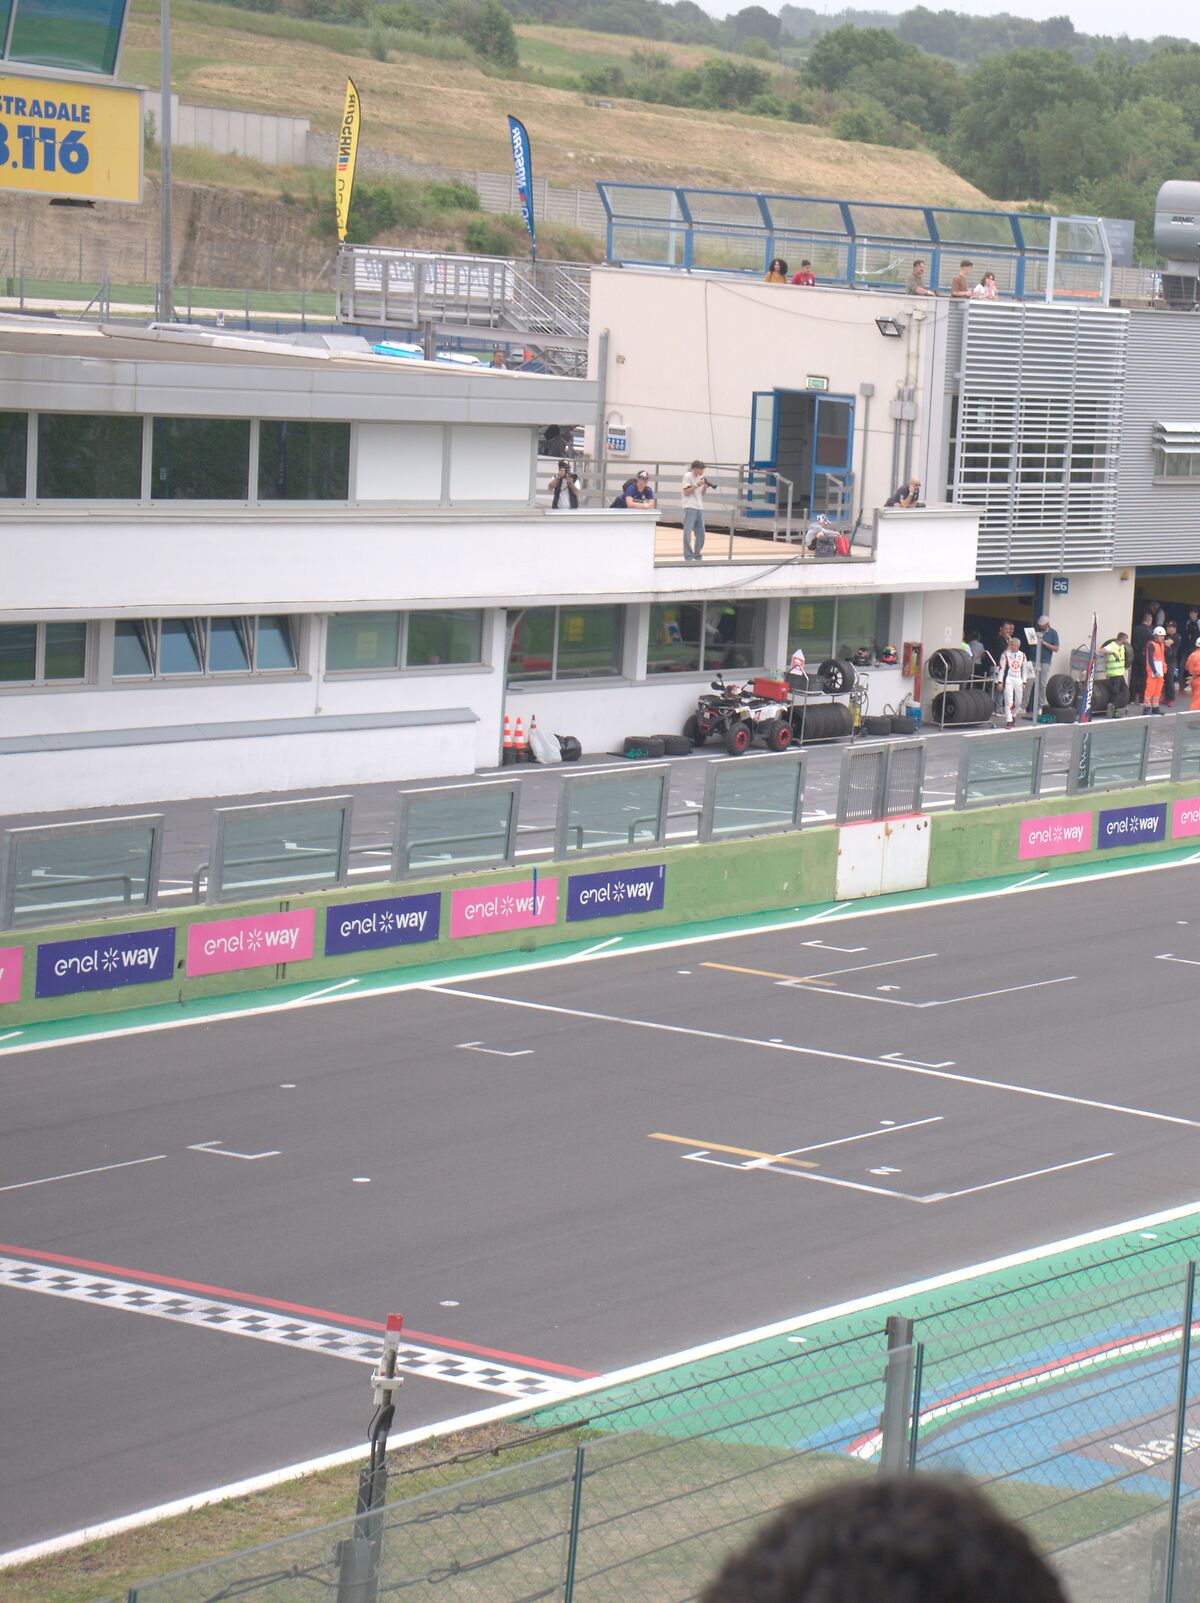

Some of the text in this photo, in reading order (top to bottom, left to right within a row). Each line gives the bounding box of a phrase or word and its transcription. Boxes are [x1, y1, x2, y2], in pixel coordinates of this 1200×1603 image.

[0, 95, 91, 123] TRADALE
[1053, 581, 1068, 591] 26
[1028, 823, 1084, 845] enel way
[1106, 814, 1160, 835] enel way
[579, 880, 654, 905] enel way
[464, 895, 545, 919] enel way
[340, 909, 427, 936] enel way
[204, 926, 300, 956] enel way
[55, 945, 160, 977] enel way
